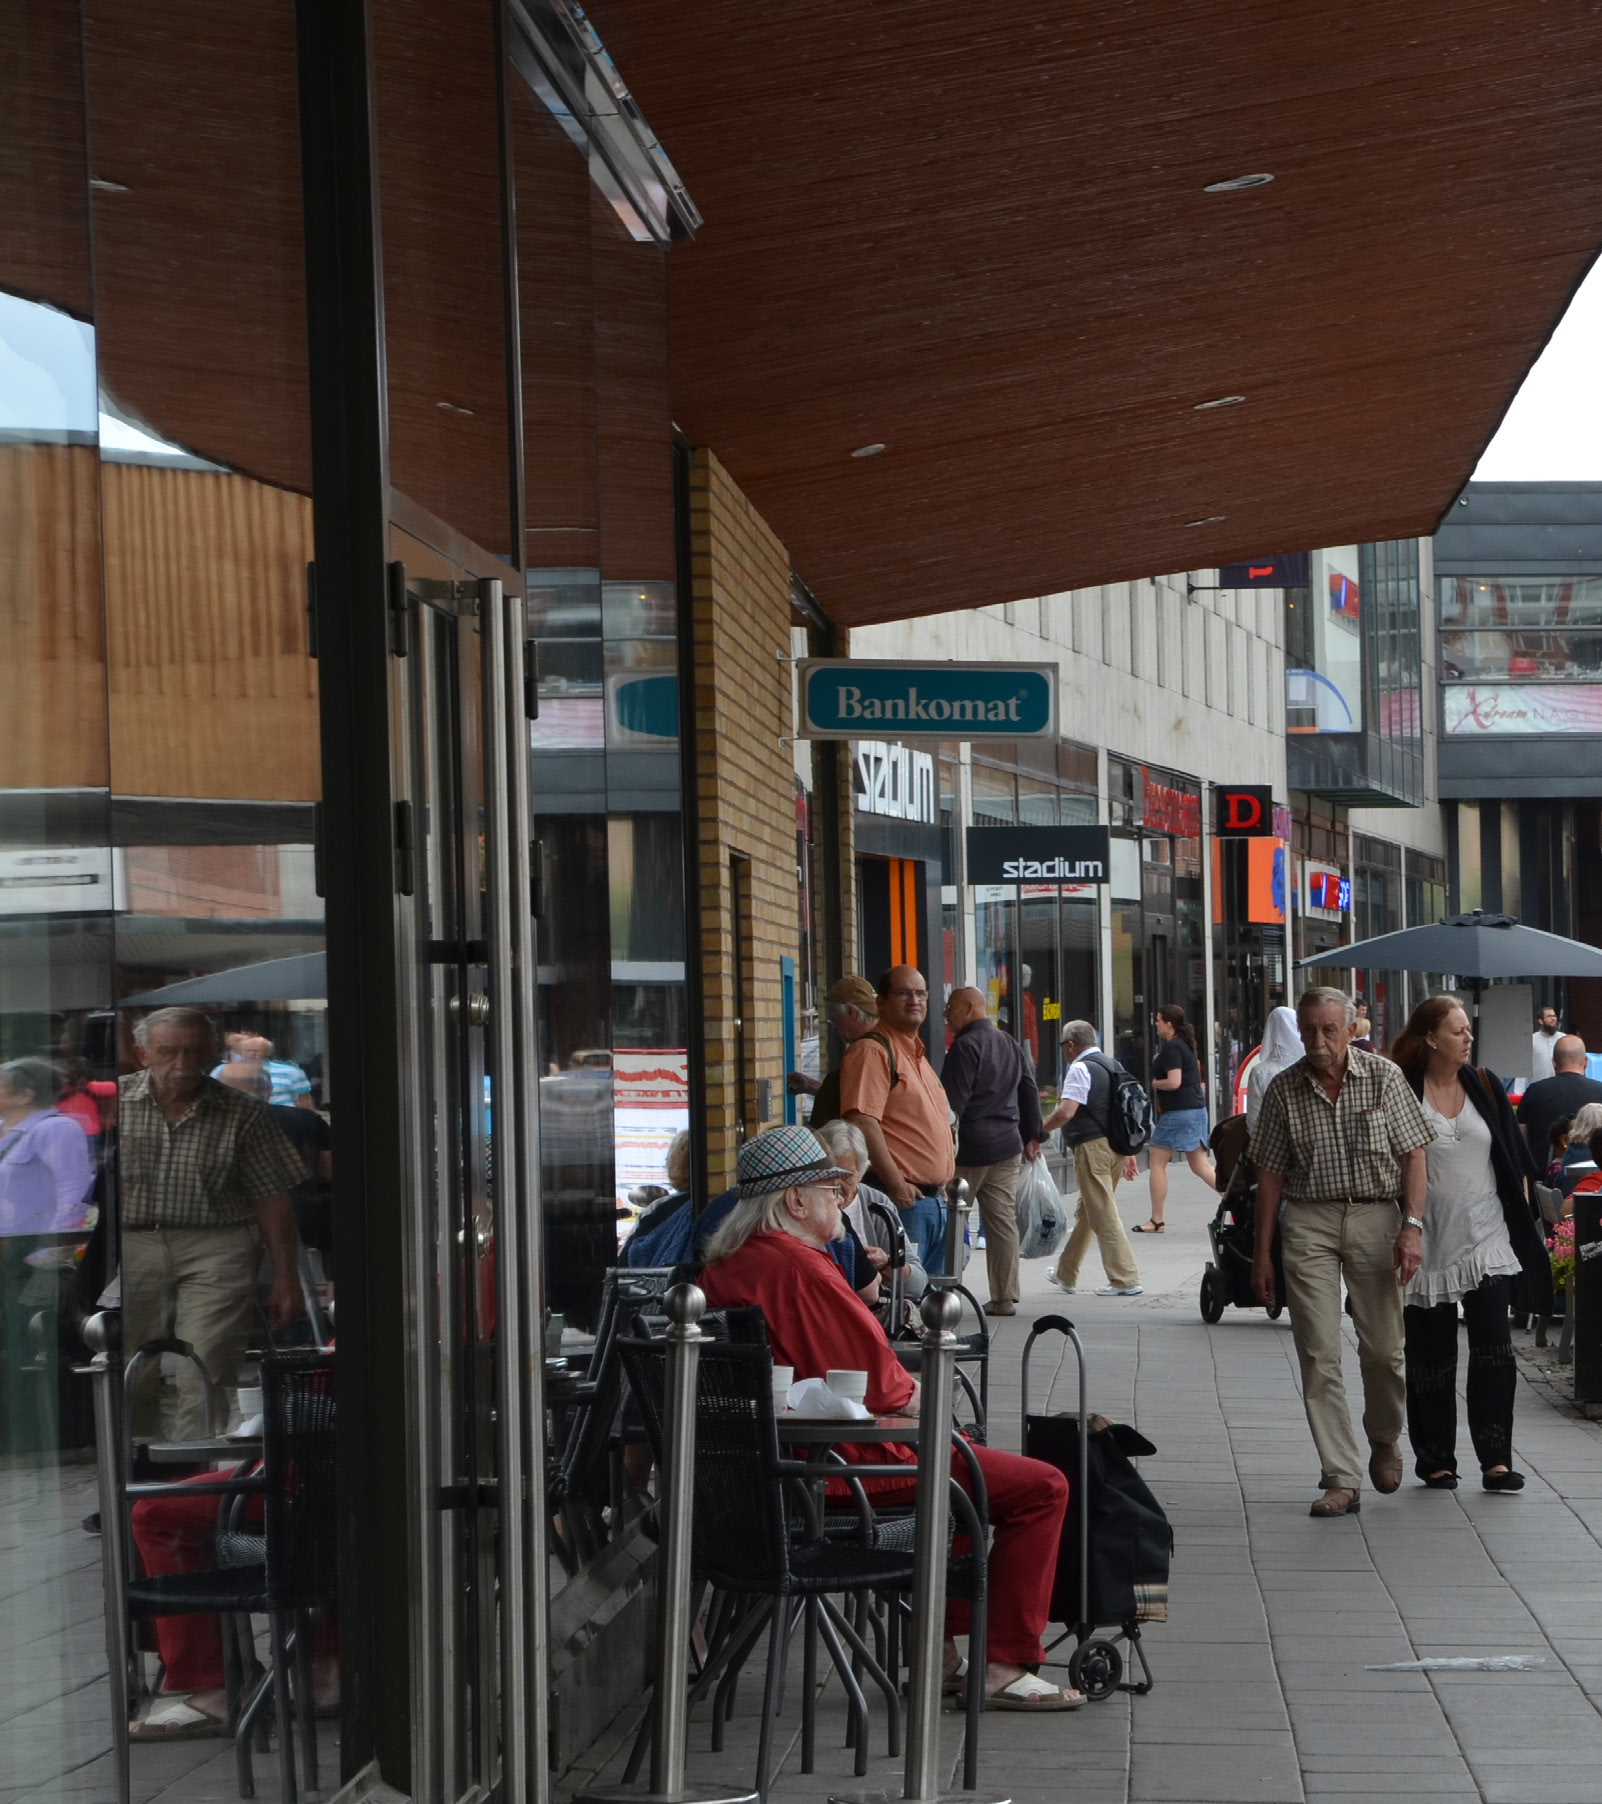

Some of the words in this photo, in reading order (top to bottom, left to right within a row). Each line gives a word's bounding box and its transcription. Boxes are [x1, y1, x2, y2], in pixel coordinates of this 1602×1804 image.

[836, 686, 1022, 722] Bankomat
[857, 741, 934, 824] stadium
[1002, 857, 1102, 878] stadium
